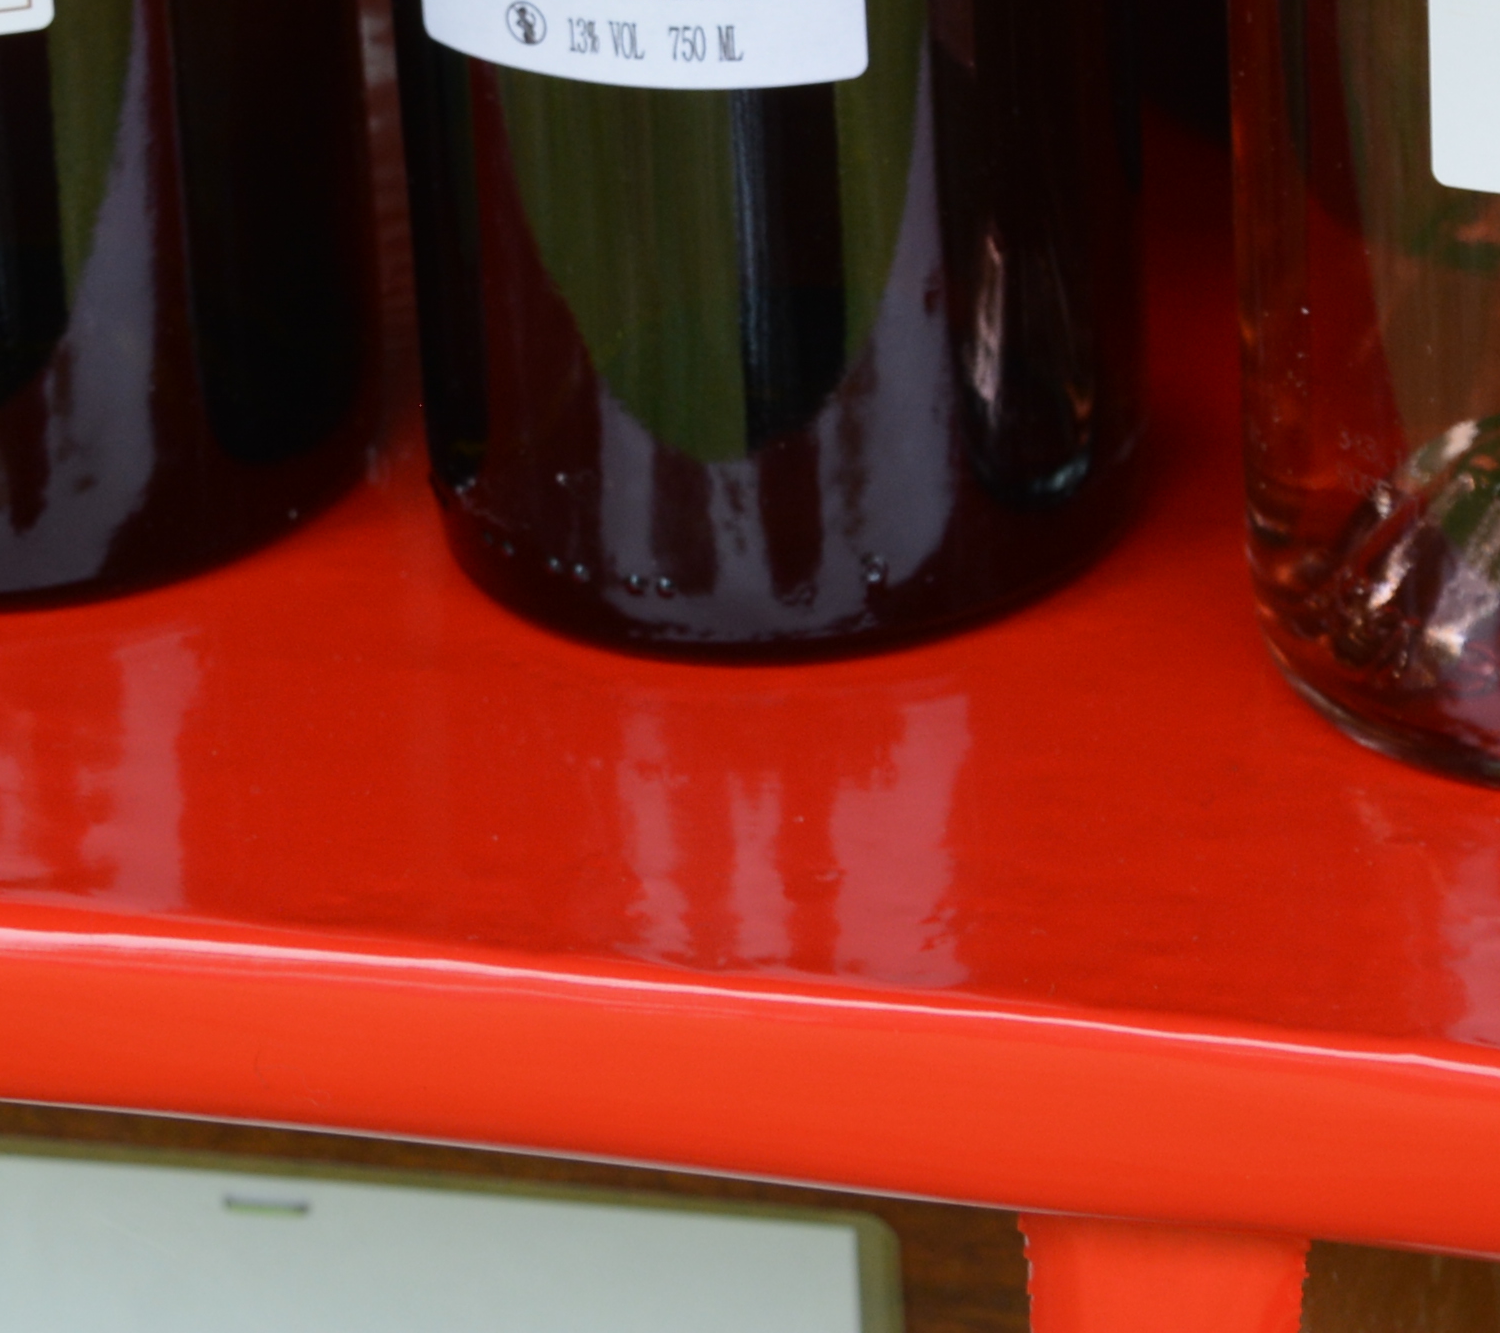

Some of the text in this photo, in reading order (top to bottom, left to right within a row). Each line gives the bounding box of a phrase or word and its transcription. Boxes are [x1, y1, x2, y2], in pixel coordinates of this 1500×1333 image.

[567, 17, 600, 55] 13%
[607, 20, 646, 61] VOL
[668, 25, 707, 63] 750
